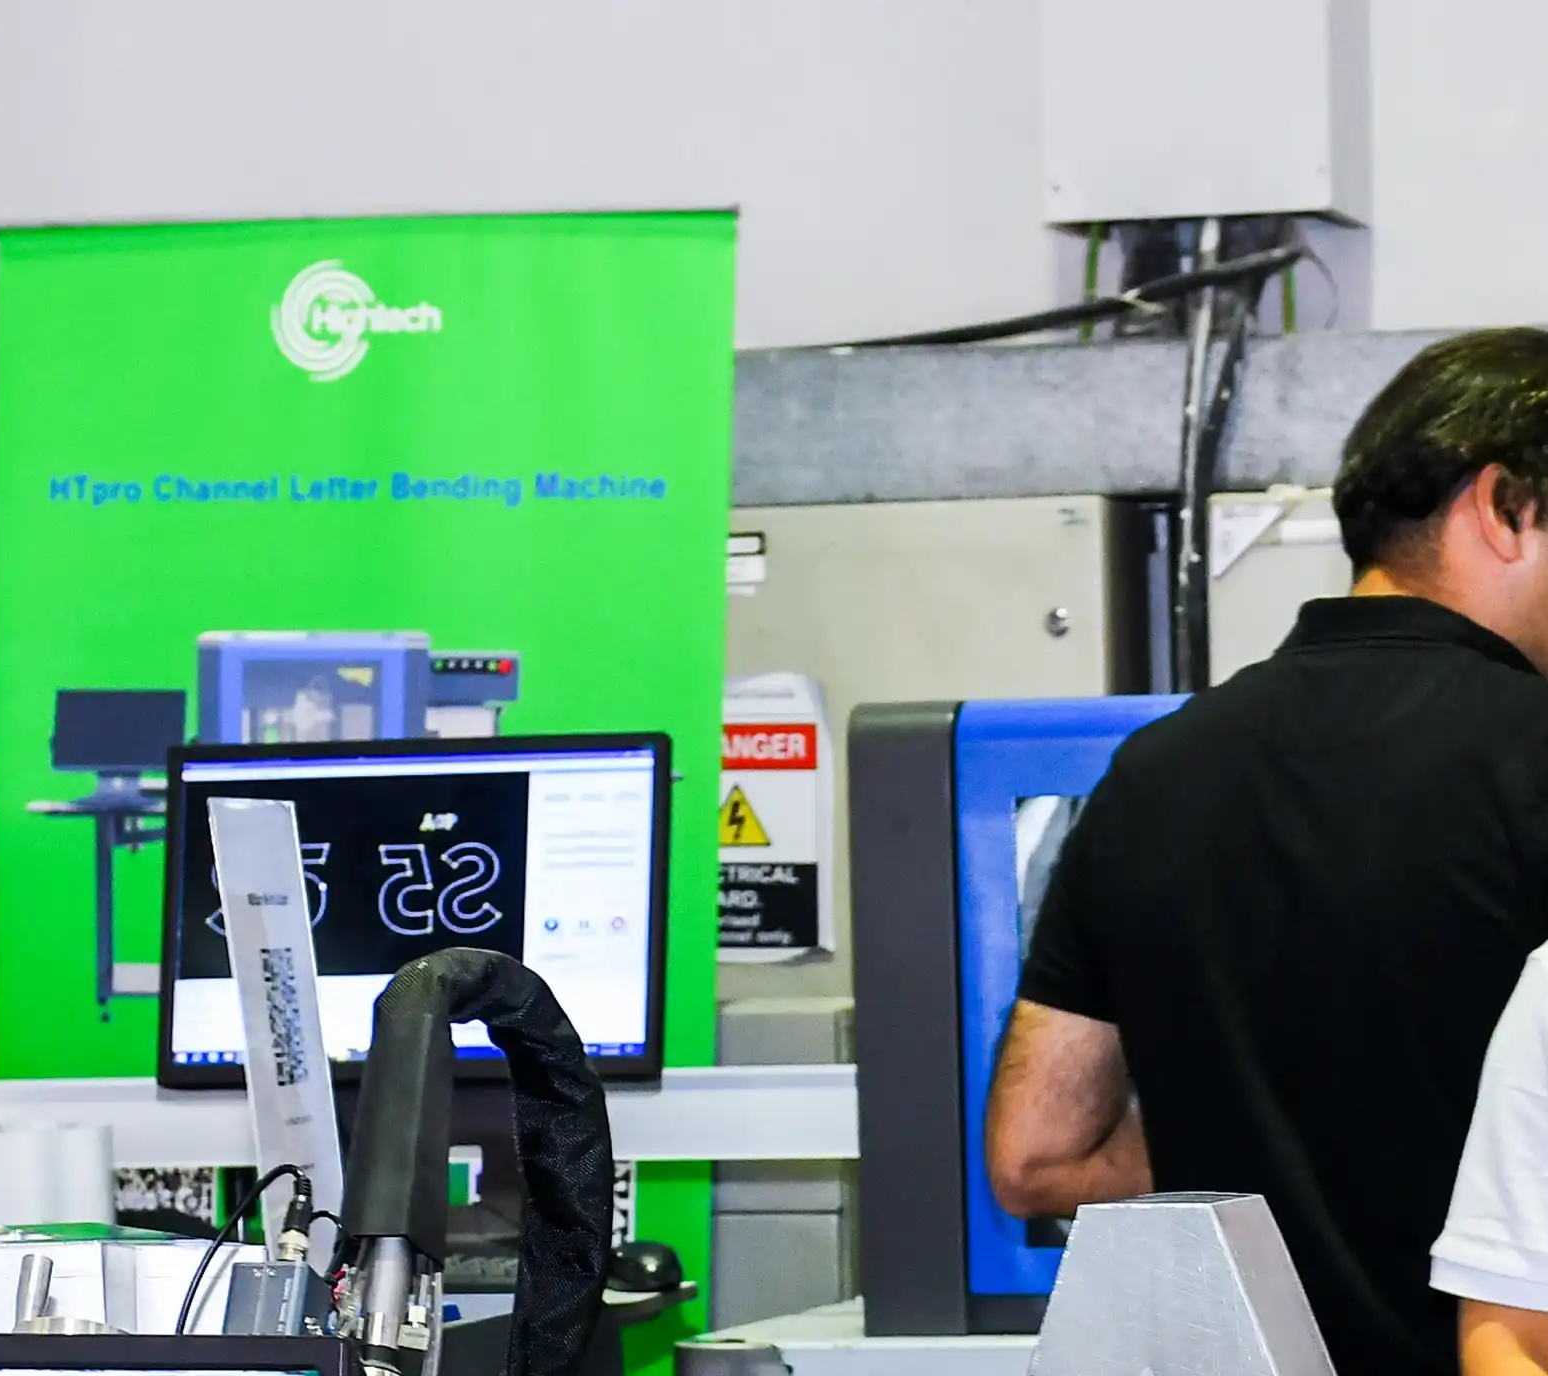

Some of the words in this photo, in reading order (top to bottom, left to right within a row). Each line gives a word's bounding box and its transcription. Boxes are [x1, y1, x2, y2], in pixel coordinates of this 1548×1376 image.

[153, 473, 279, 503] Channel
[289, 473, 379, 502] Letter
[390, 473, 522, 508] Bending
[534, 470, 668, 501] Machine
[722, 732, 806, 759] ANGER
